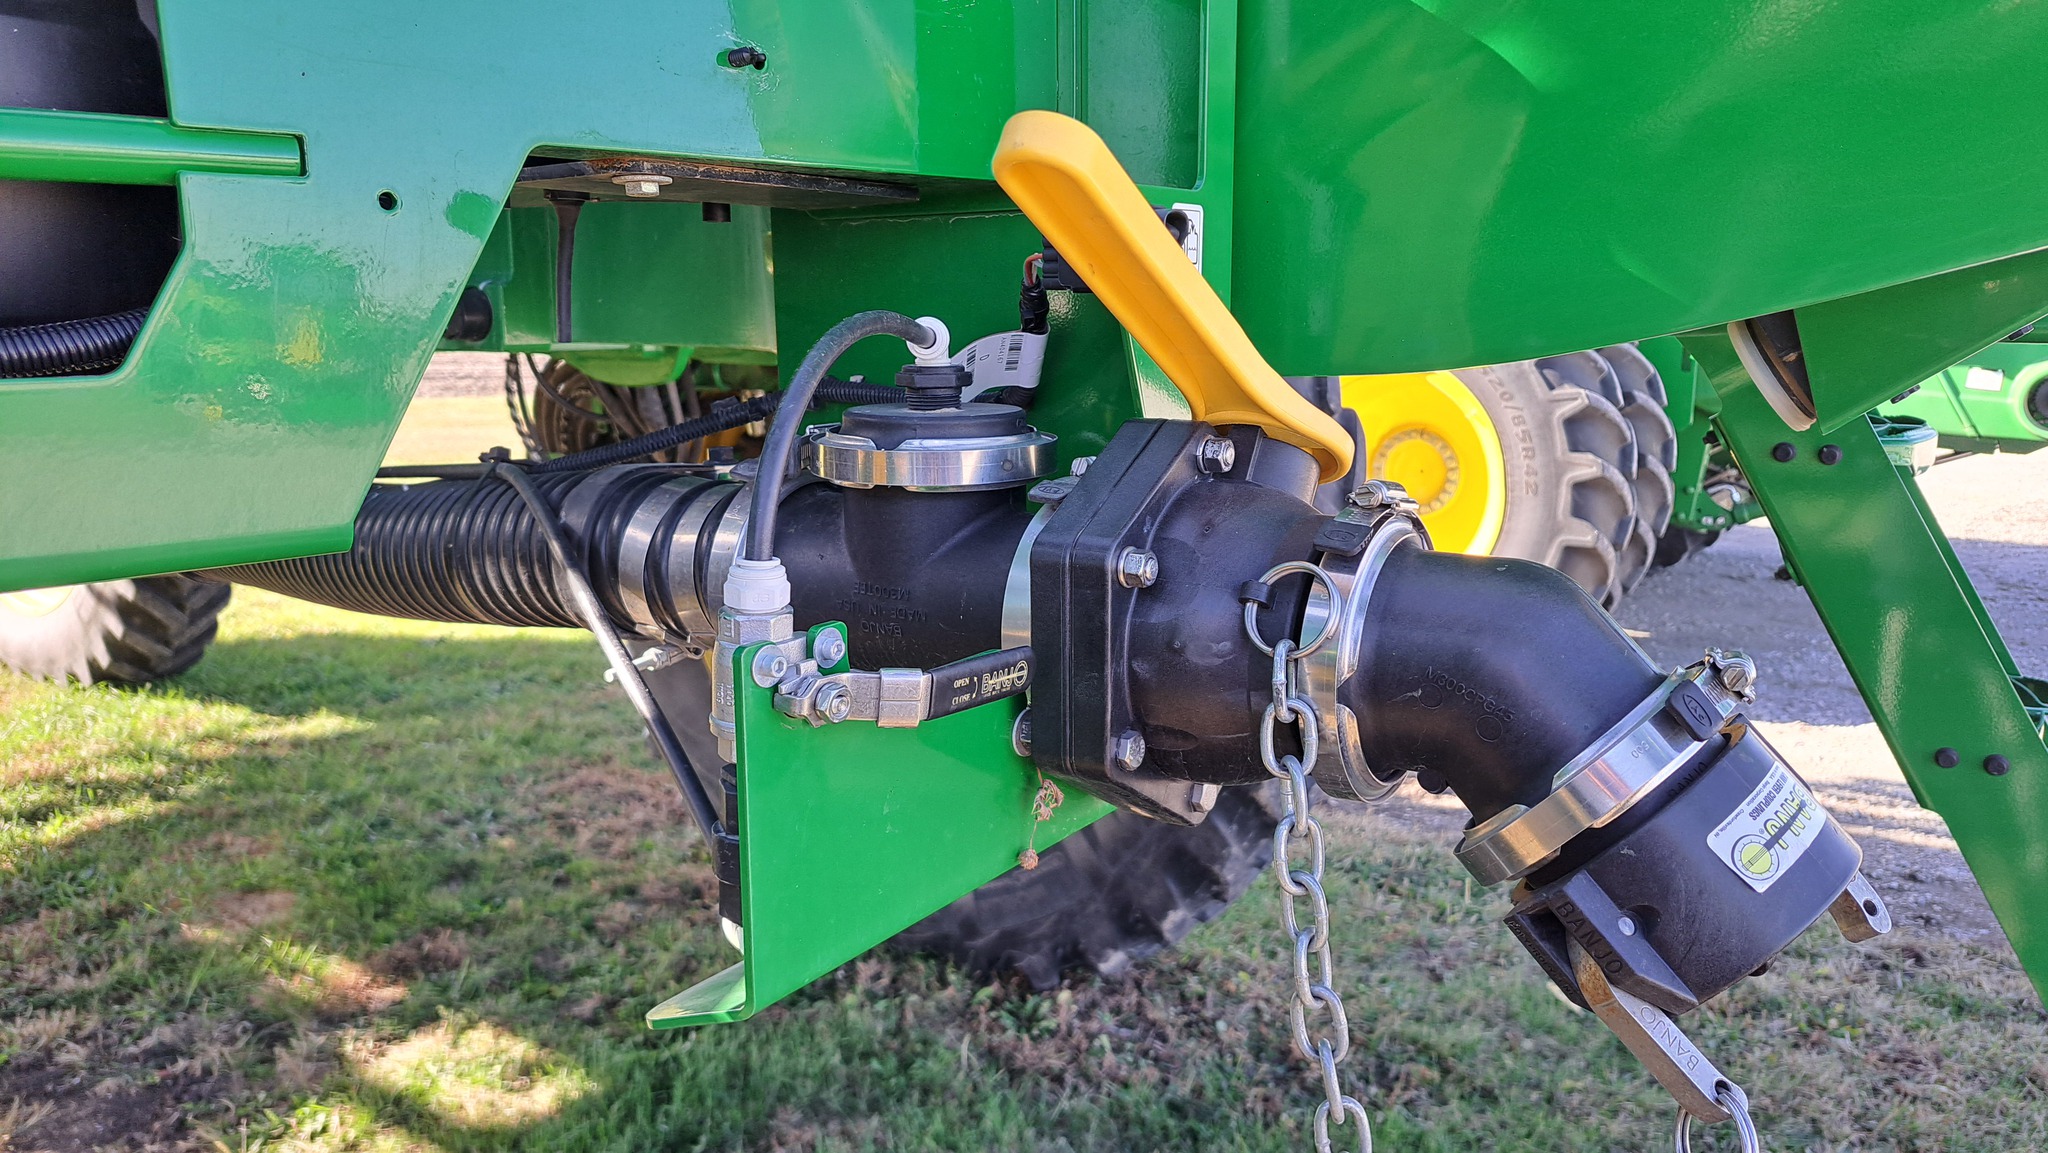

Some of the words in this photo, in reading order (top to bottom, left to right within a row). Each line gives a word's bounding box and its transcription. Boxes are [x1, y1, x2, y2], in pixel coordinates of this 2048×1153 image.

[890, 605, 927, 621] MADE
[861, 620, 902, 637] BANJO
[953, 676, 971, 689] OPEN
[1424, 665, 1516, 721] M300CPG45
[951, 693, 972, 706] CLOSE
[1748, 790, 1777, 821] COUPLINGS
[1555, 901, 1624, 975] BANJO
[1640, 1005, 1700, 1072] BANJO
